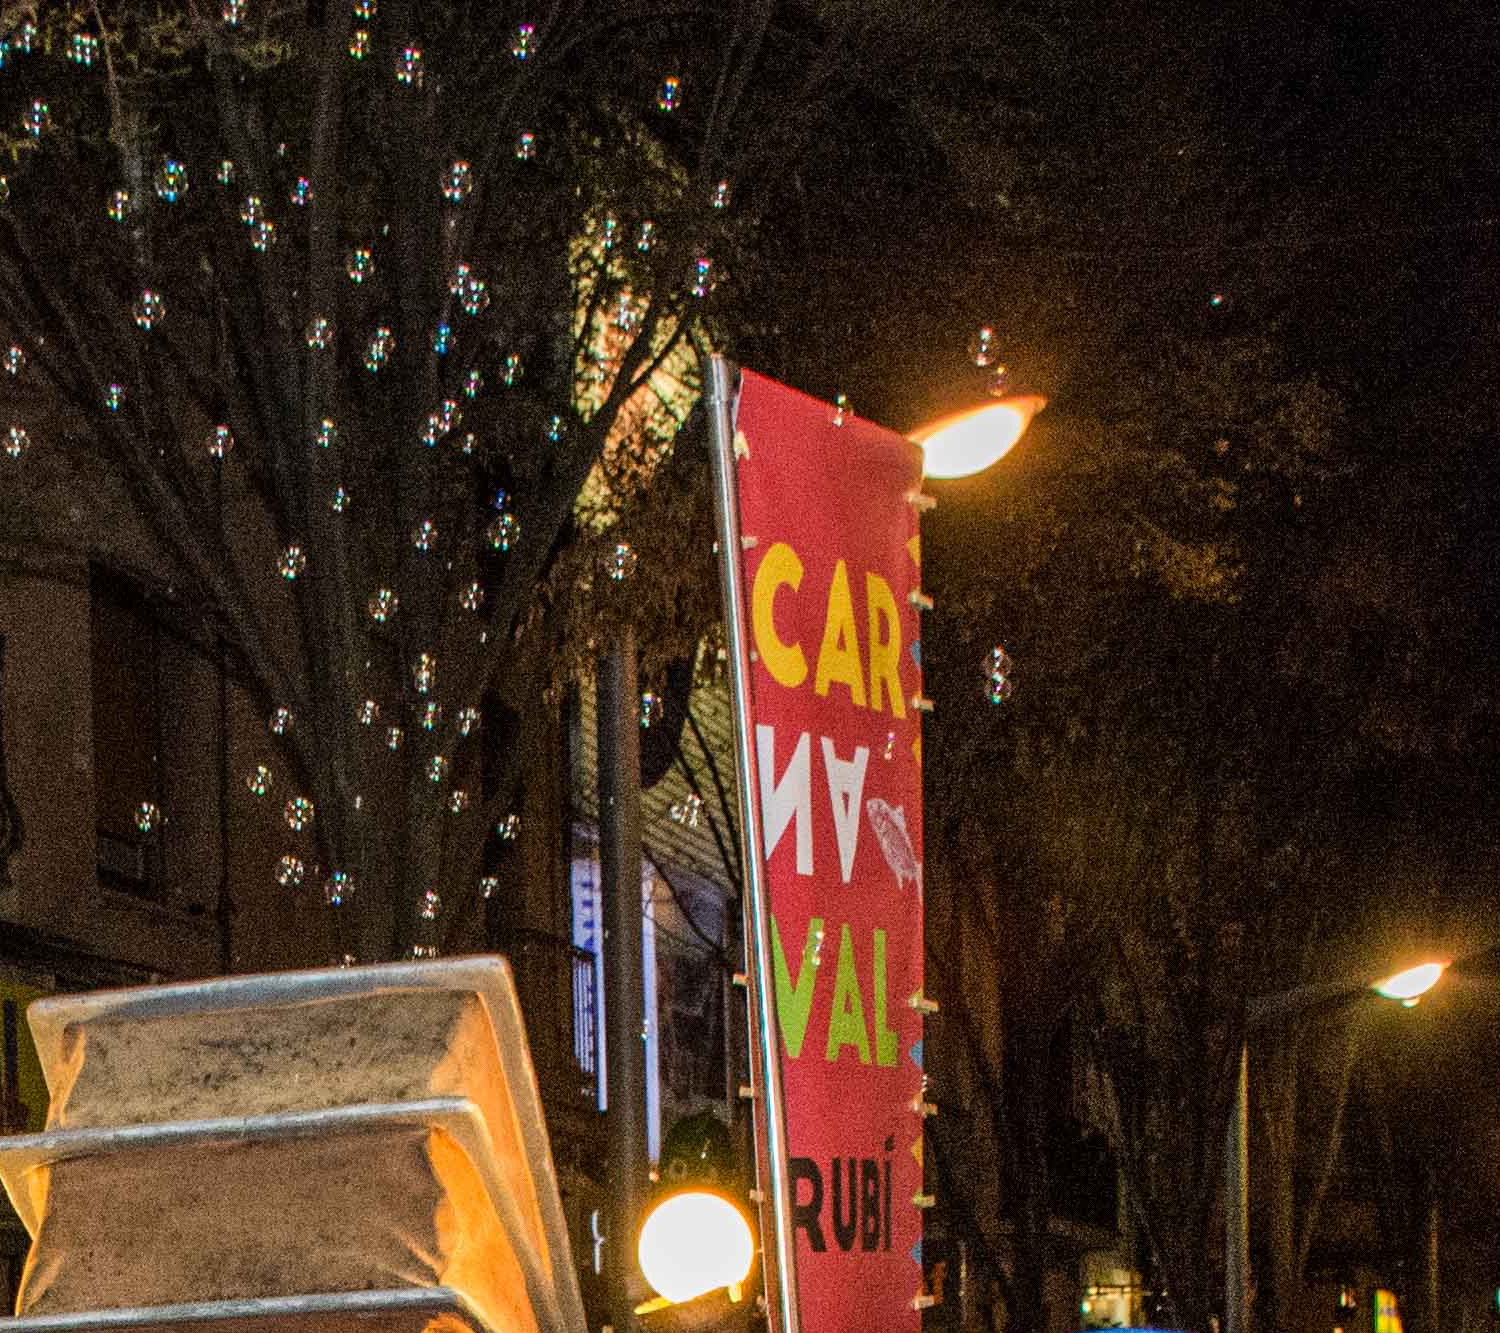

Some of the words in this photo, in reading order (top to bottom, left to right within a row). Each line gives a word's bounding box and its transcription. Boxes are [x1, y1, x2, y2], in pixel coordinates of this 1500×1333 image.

[752, 542, 907, 720] CAR
[770, 914, 899, 1067] VAL
[788, 1134, 895, 1254] RUBÍ
